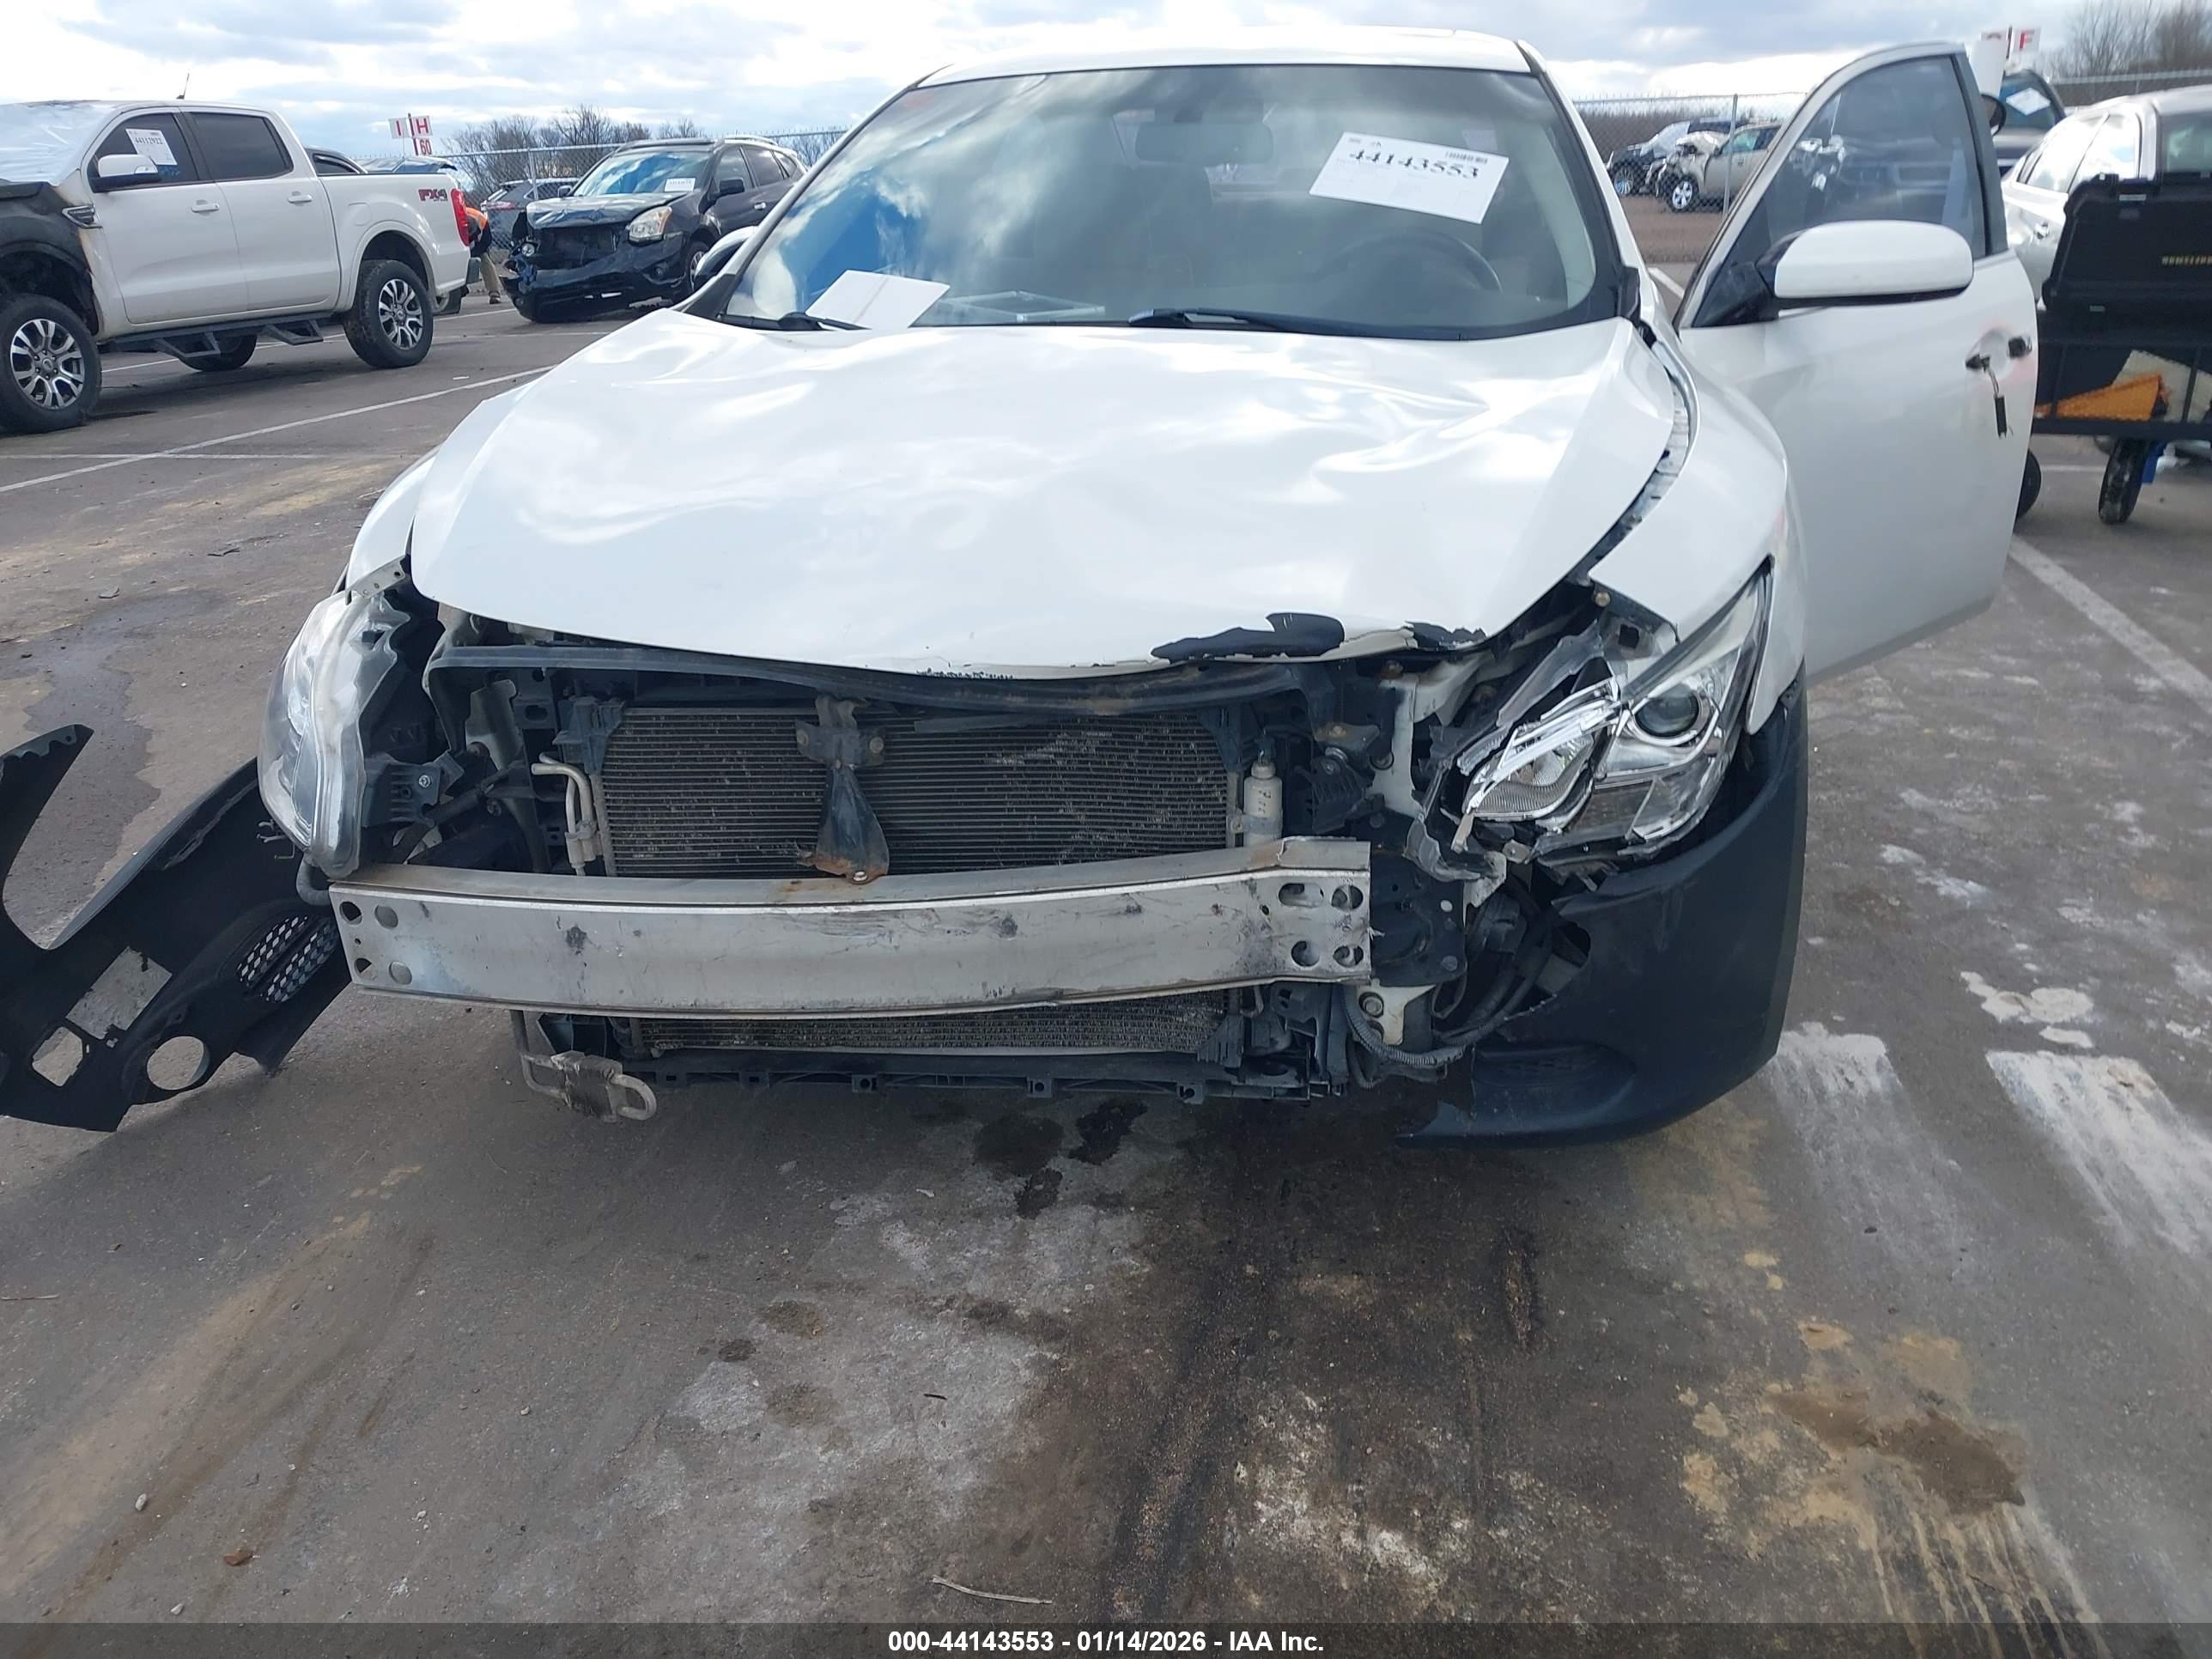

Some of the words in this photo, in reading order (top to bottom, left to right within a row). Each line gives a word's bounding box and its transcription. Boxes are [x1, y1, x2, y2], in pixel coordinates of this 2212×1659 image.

[2019, 28, 2034, 50] F
[416, 118, 429, 134] H
[419, 138, 432, 155] 60
[1348, 149, 1480, 179] 44143553
[418, 189, 448, 202] FX4
